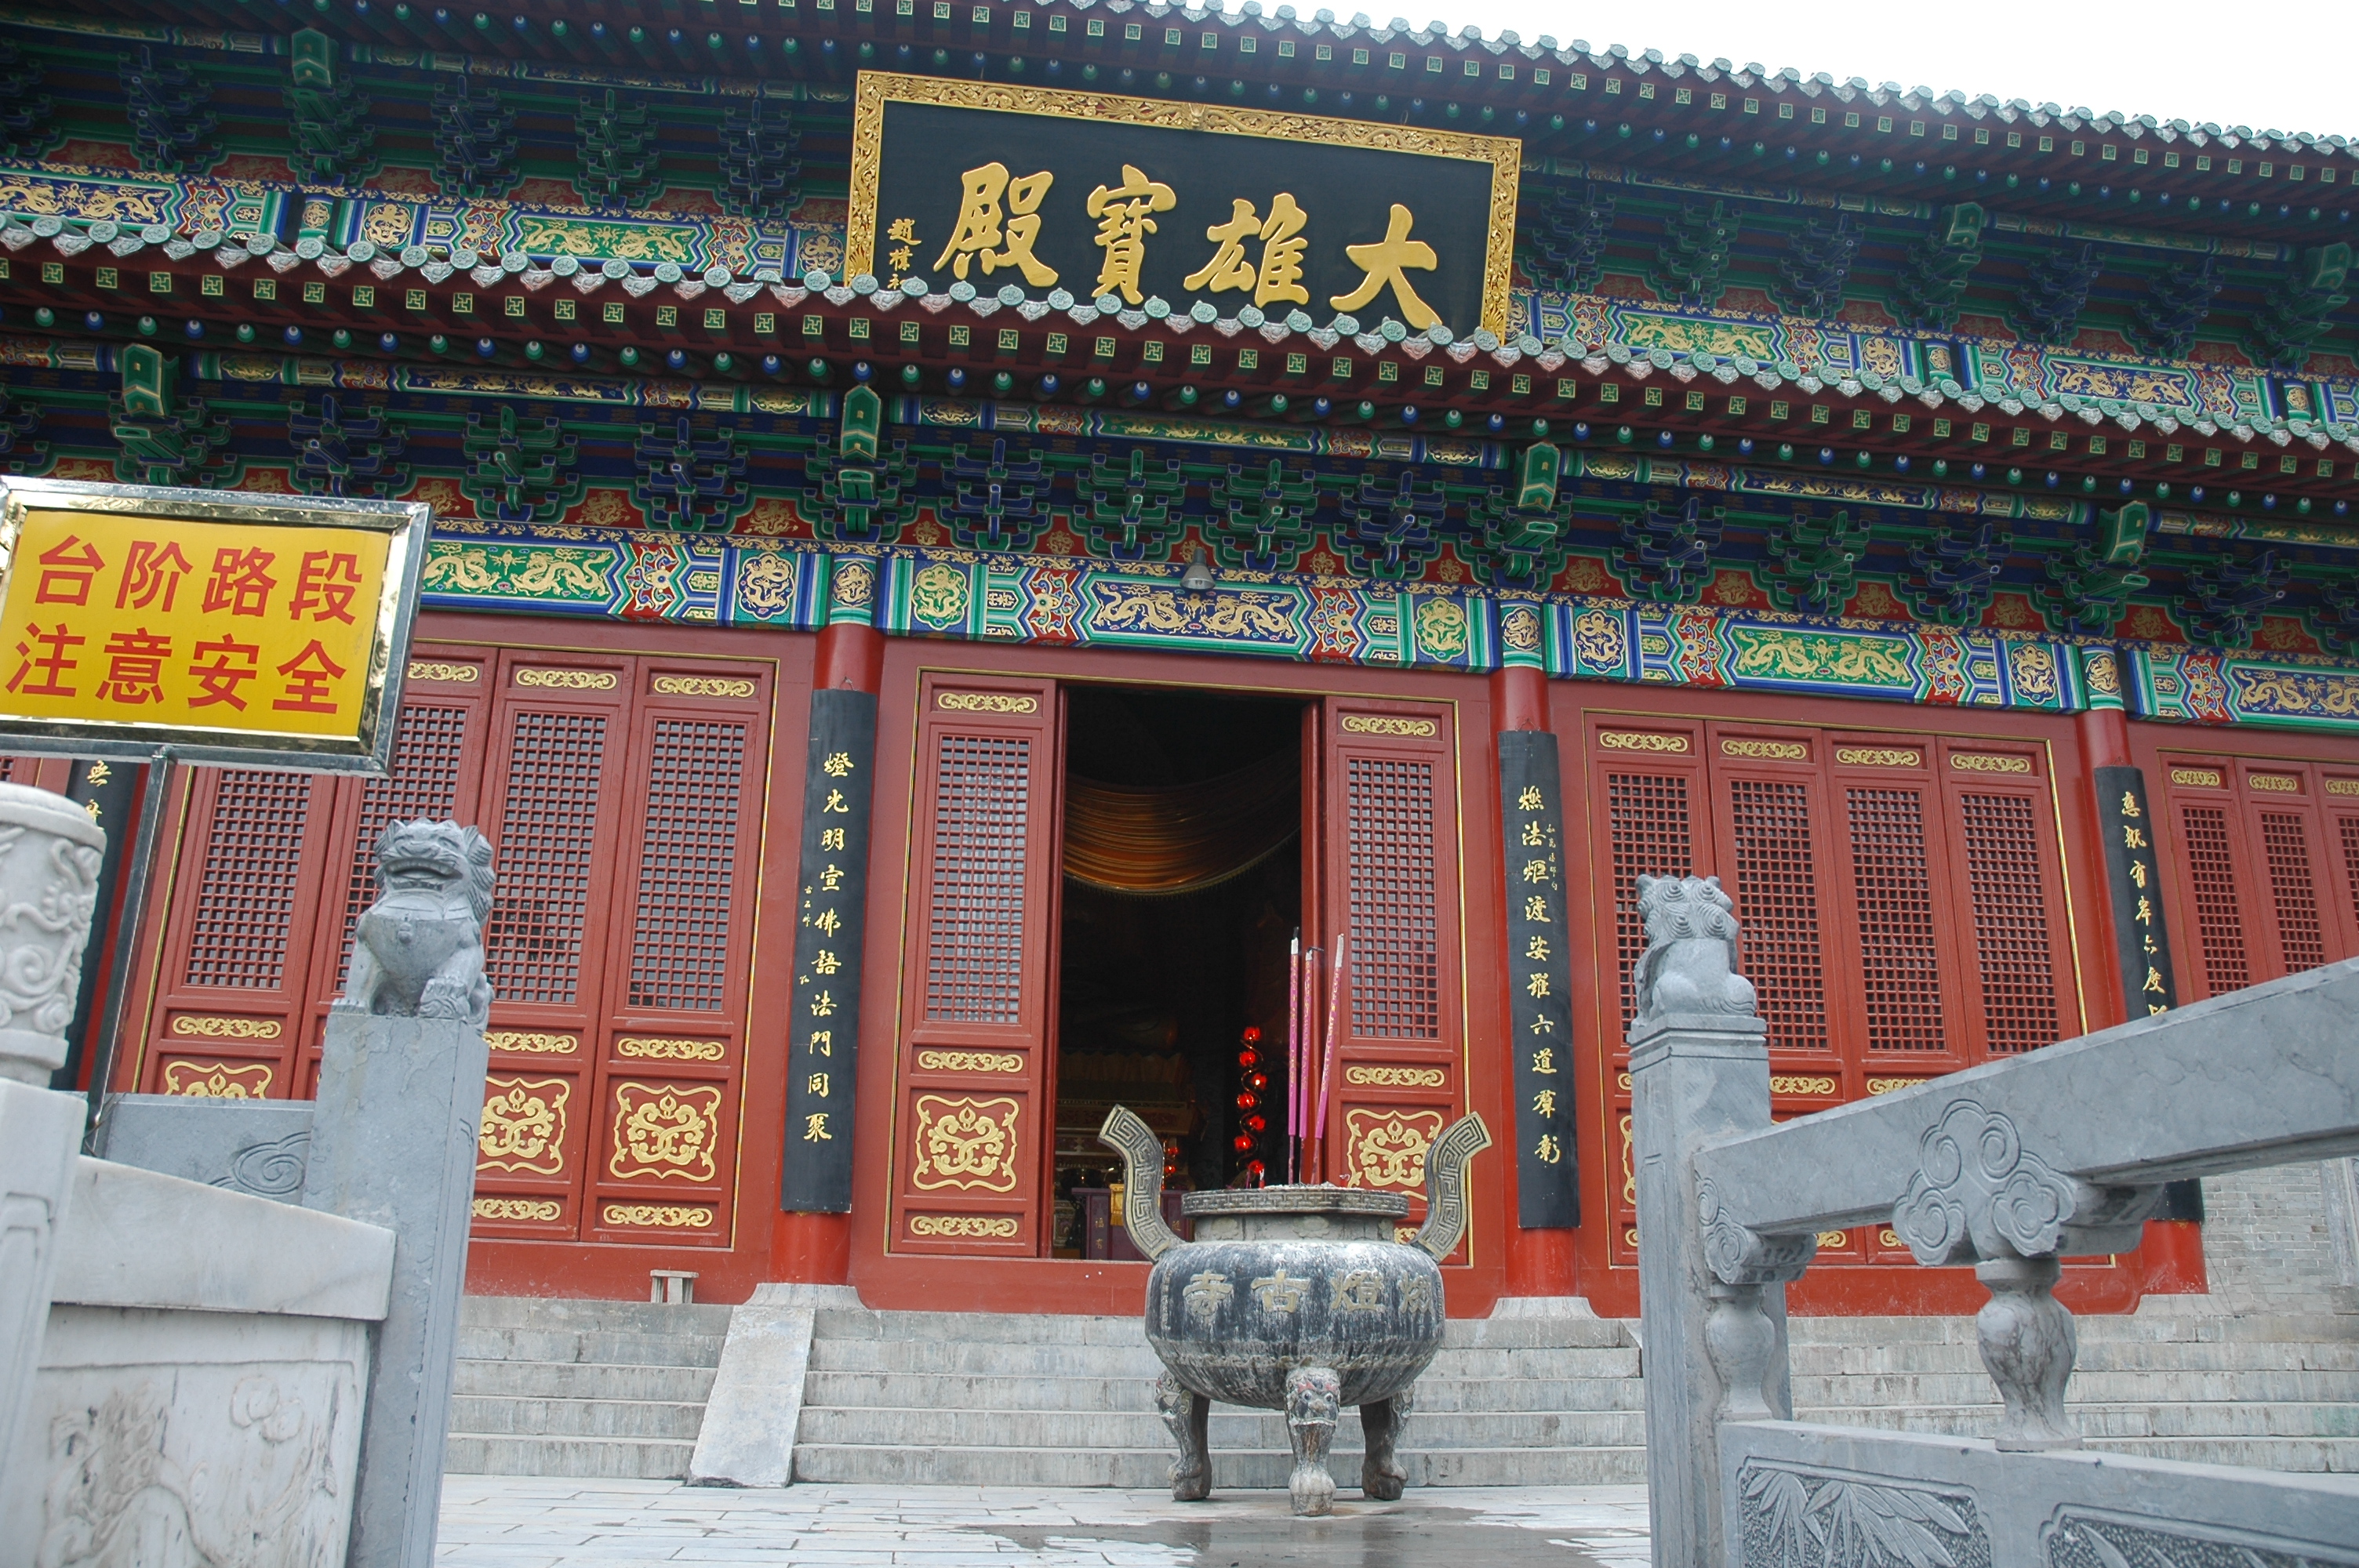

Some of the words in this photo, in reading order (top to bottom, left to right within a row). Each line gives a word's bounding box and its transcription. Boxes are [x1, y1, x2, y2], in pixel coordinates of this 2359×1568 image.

[35, 535, 362, 626] 台阶路段
[5, 622, 346, 714] 注意安全
